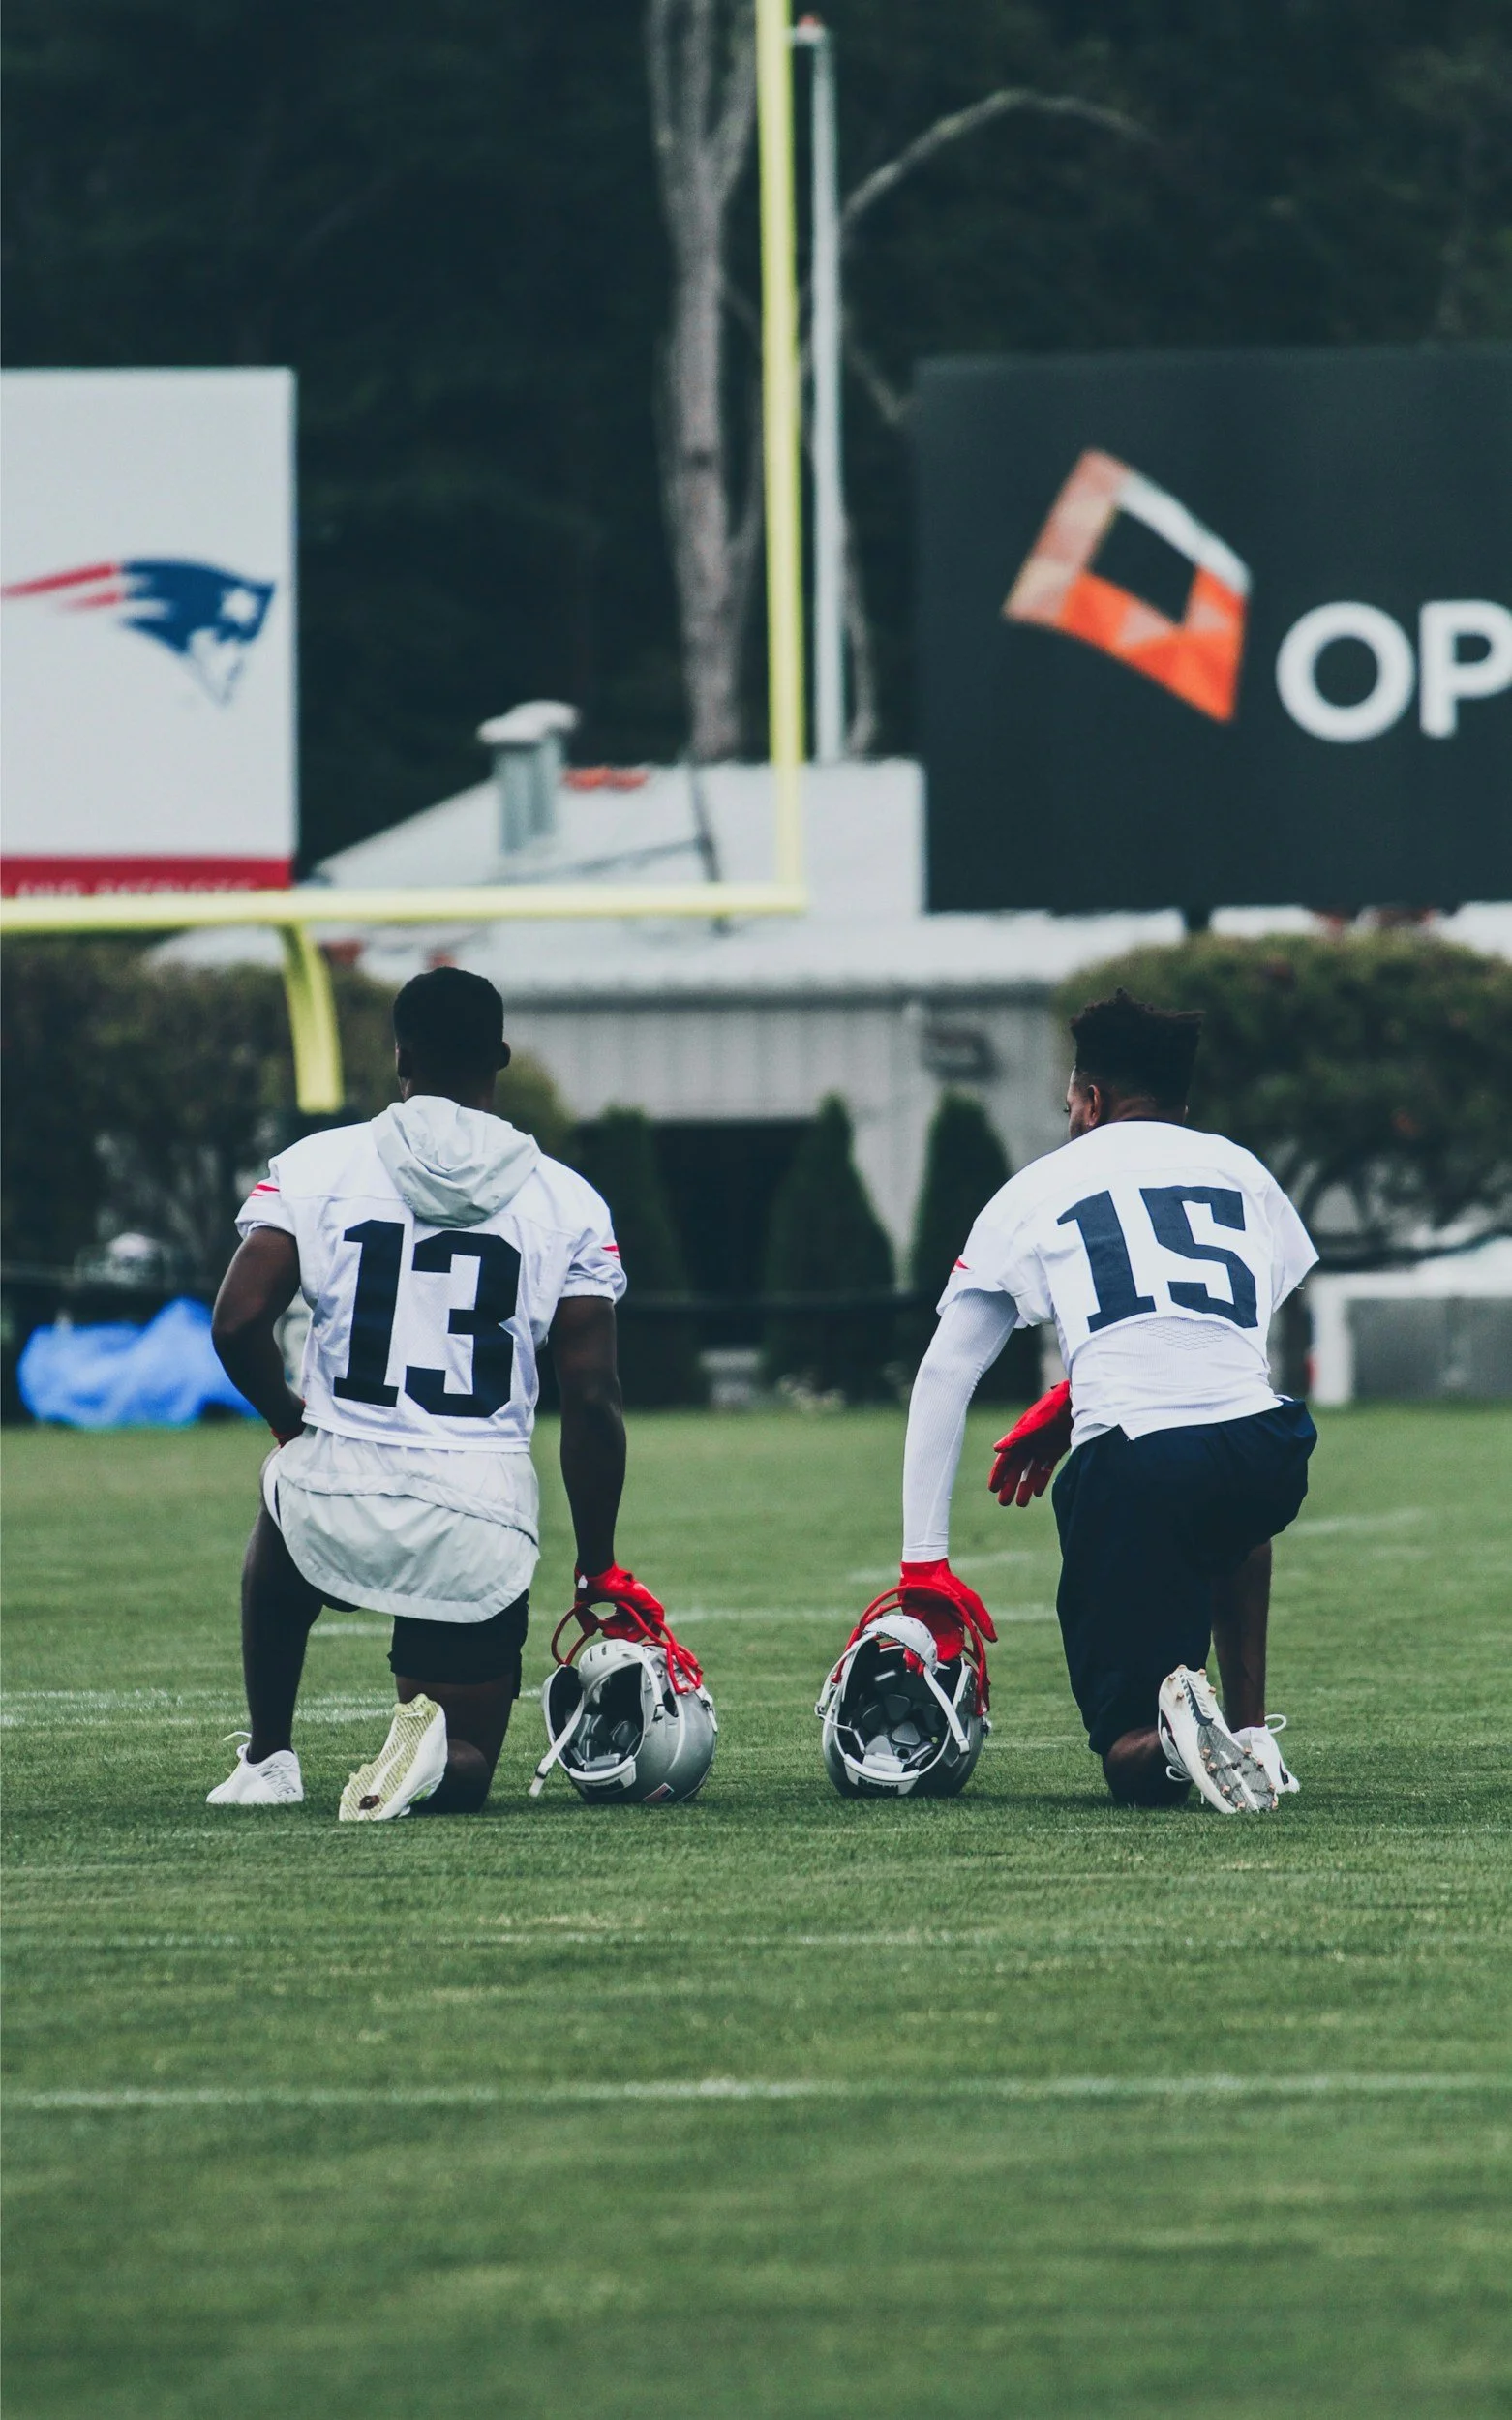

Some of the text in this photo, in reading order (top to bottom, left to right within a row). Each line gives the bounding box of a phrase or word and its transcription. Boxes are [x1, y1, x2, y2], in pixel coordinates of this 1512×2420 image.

[1275, 599, 1512, 743] OP
[333, 1219, 522, 1418] 13
[1056, 1185, 1258, 1333] 15
